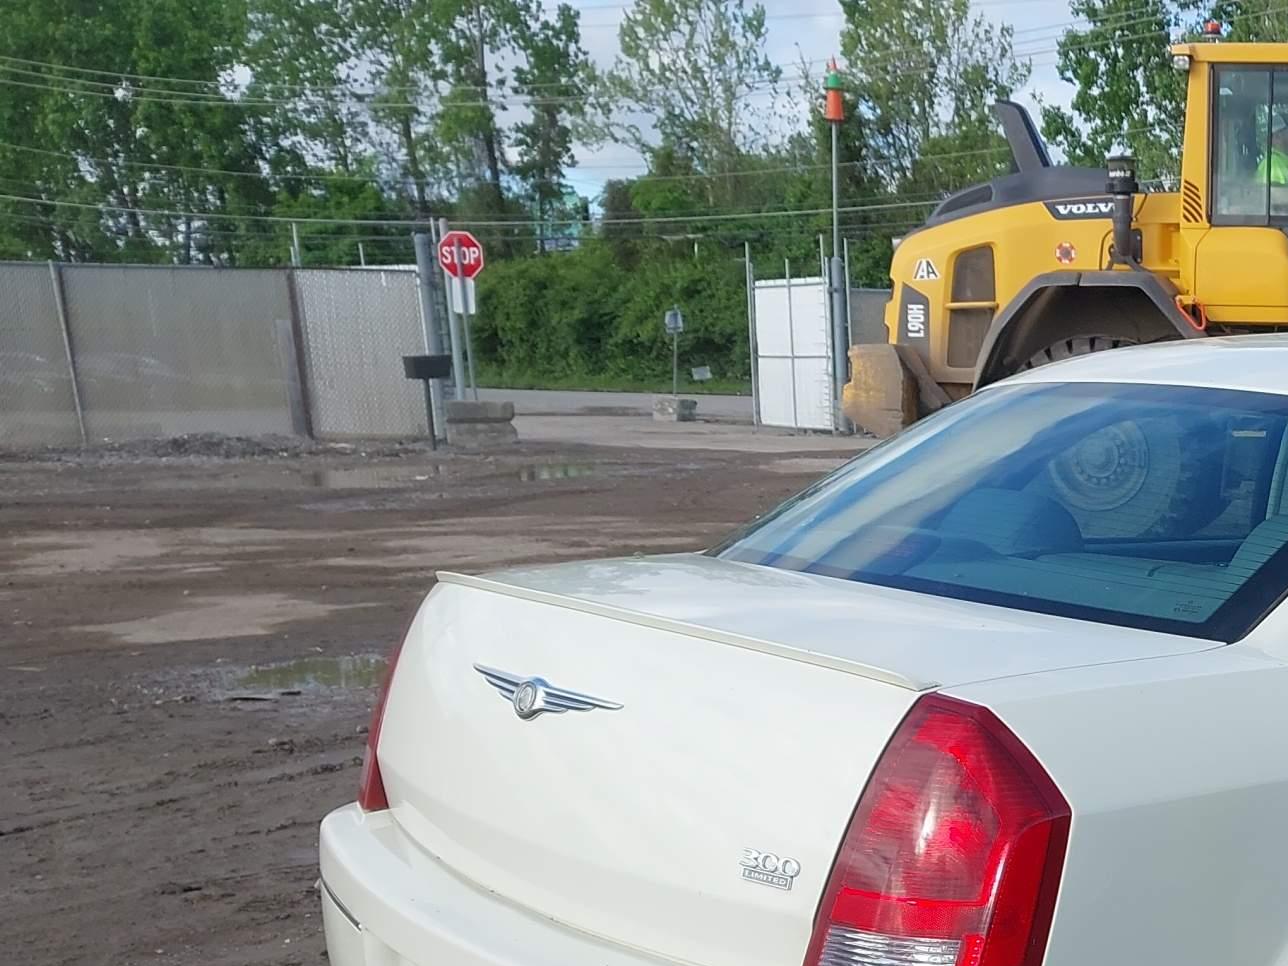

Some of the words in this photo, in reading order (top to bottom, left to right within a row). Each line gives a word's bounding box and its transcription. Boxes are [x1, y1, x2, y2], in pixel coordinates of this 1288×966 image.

[1055, 203, 1115, 214] VOLV
[441, 246, 479, 265] STOP
[907, 304, 925, 338] L90H
[740, 847, 801, 877] 300
[744, 870, 787, 886] LIMITED
